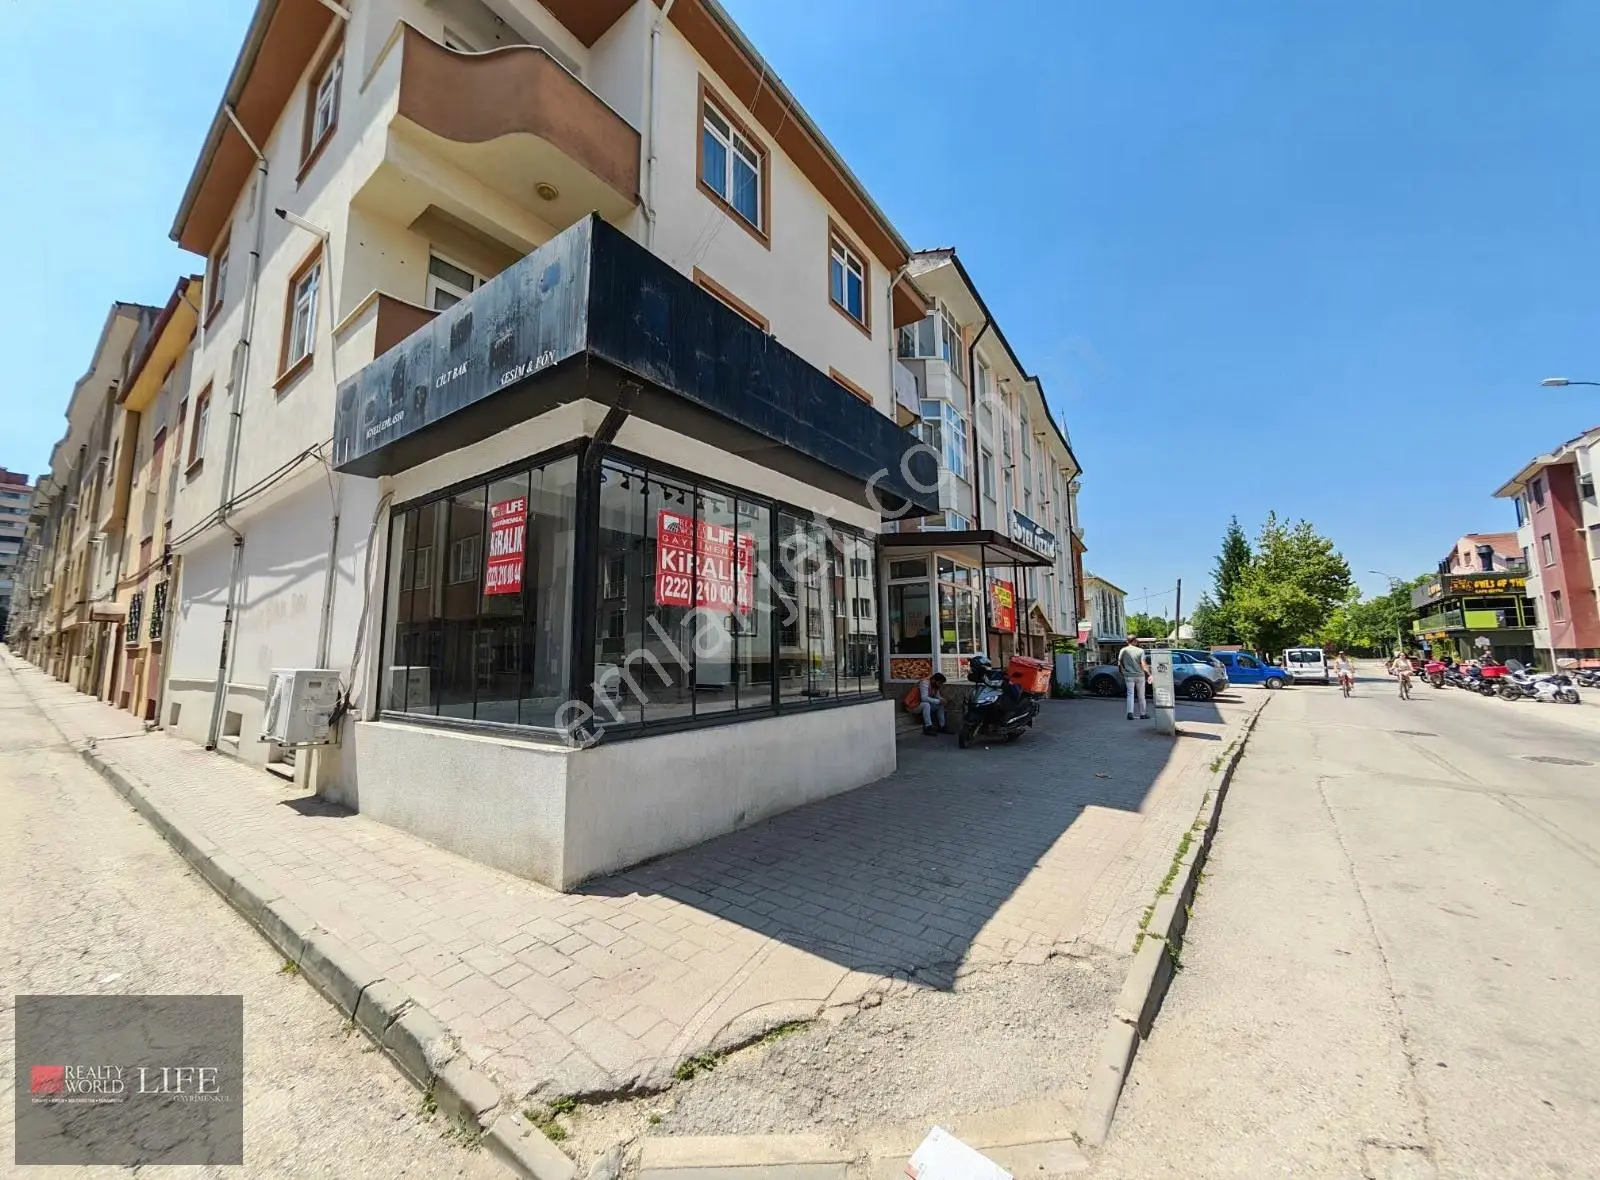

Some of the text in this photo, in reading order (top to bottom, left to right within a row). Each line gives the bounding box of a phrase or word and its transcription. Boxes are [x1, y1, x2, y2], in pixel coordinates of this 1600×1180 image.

[526, 360, 533, 373] &
[506, 499, 524, 513] LIFE
[706, 526, 747, 549] LIFE
[661, 574, 692, 605] (222)
[696, 580, 717, 602] 210
[720, 584, 736, 604] 00
